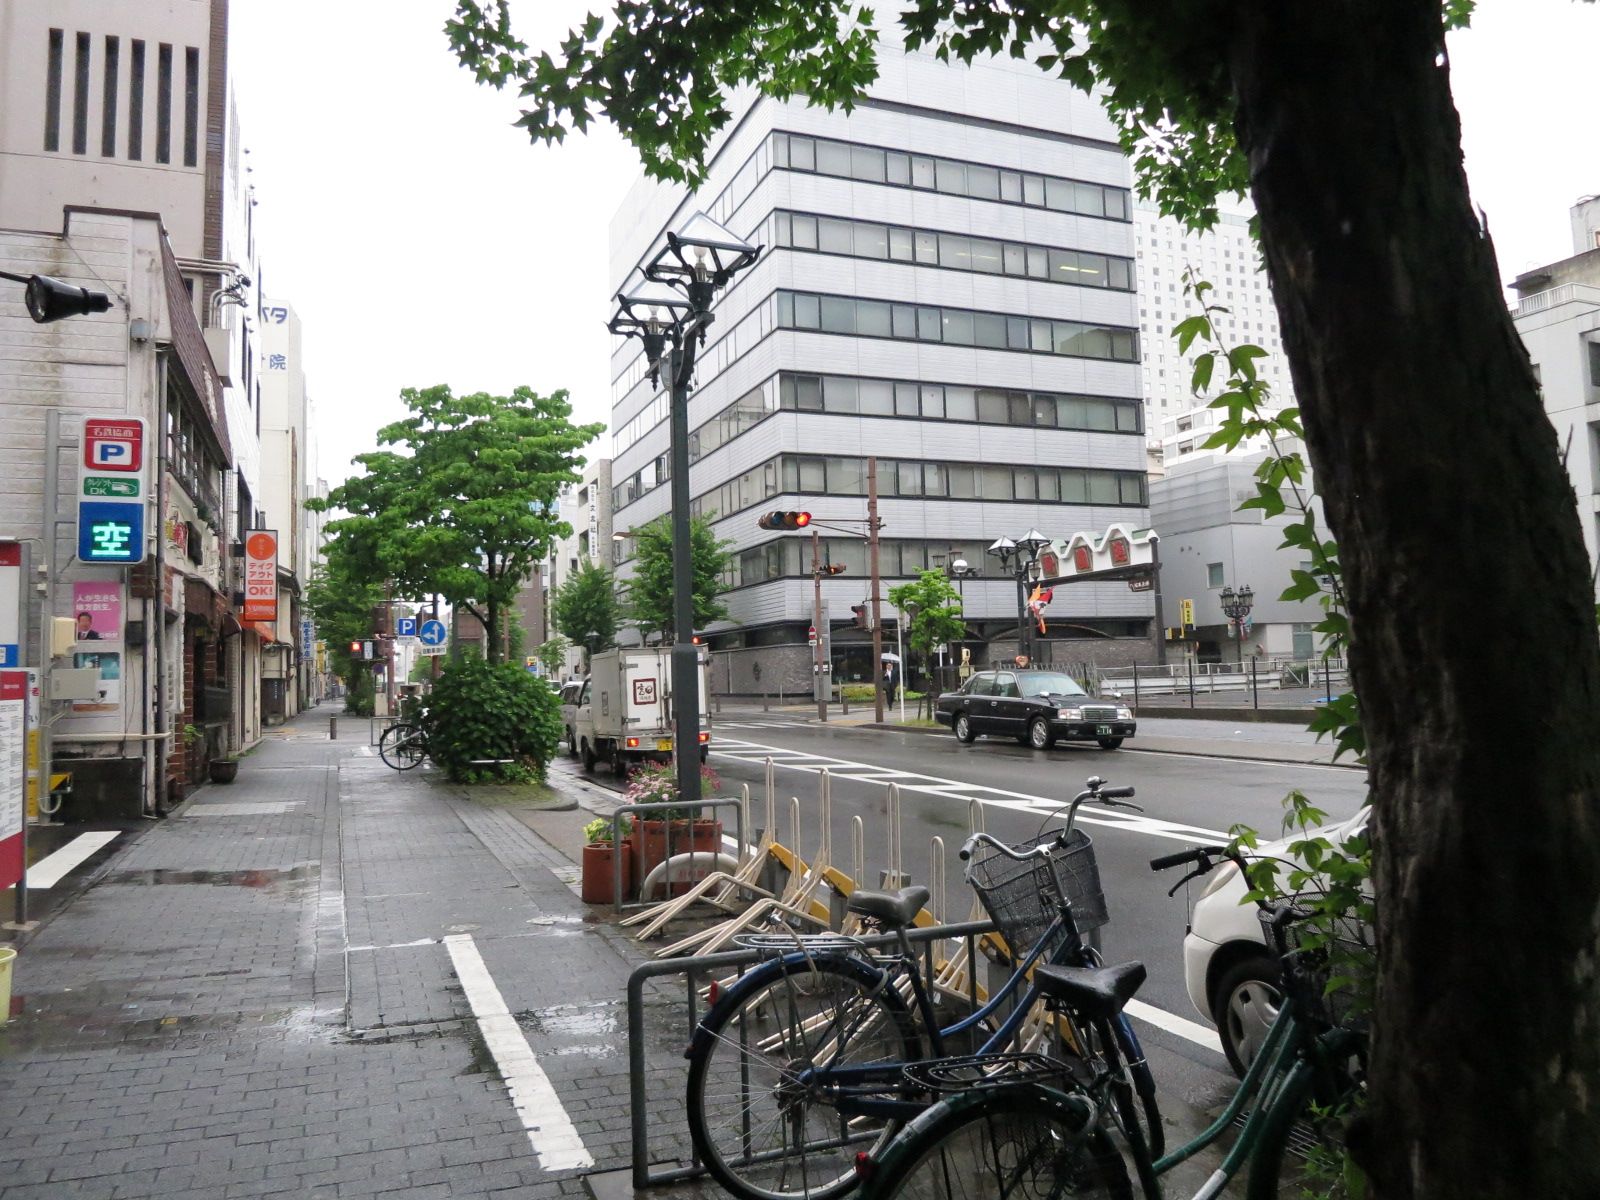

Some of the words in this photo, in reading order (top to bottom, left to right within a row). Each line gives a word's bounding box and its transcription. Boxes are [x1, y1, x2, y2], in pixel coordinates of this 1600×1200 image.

[100, 444, 125, 462] P
[90, 487, 107, 495] OK
[91, 522, 131, 556] 空
[248, 562, 273, 570] テイク
[248, 571, 273, 579] アウト
[248, 586, 273, 596] OK!
[402, 621, 412, 634] P
